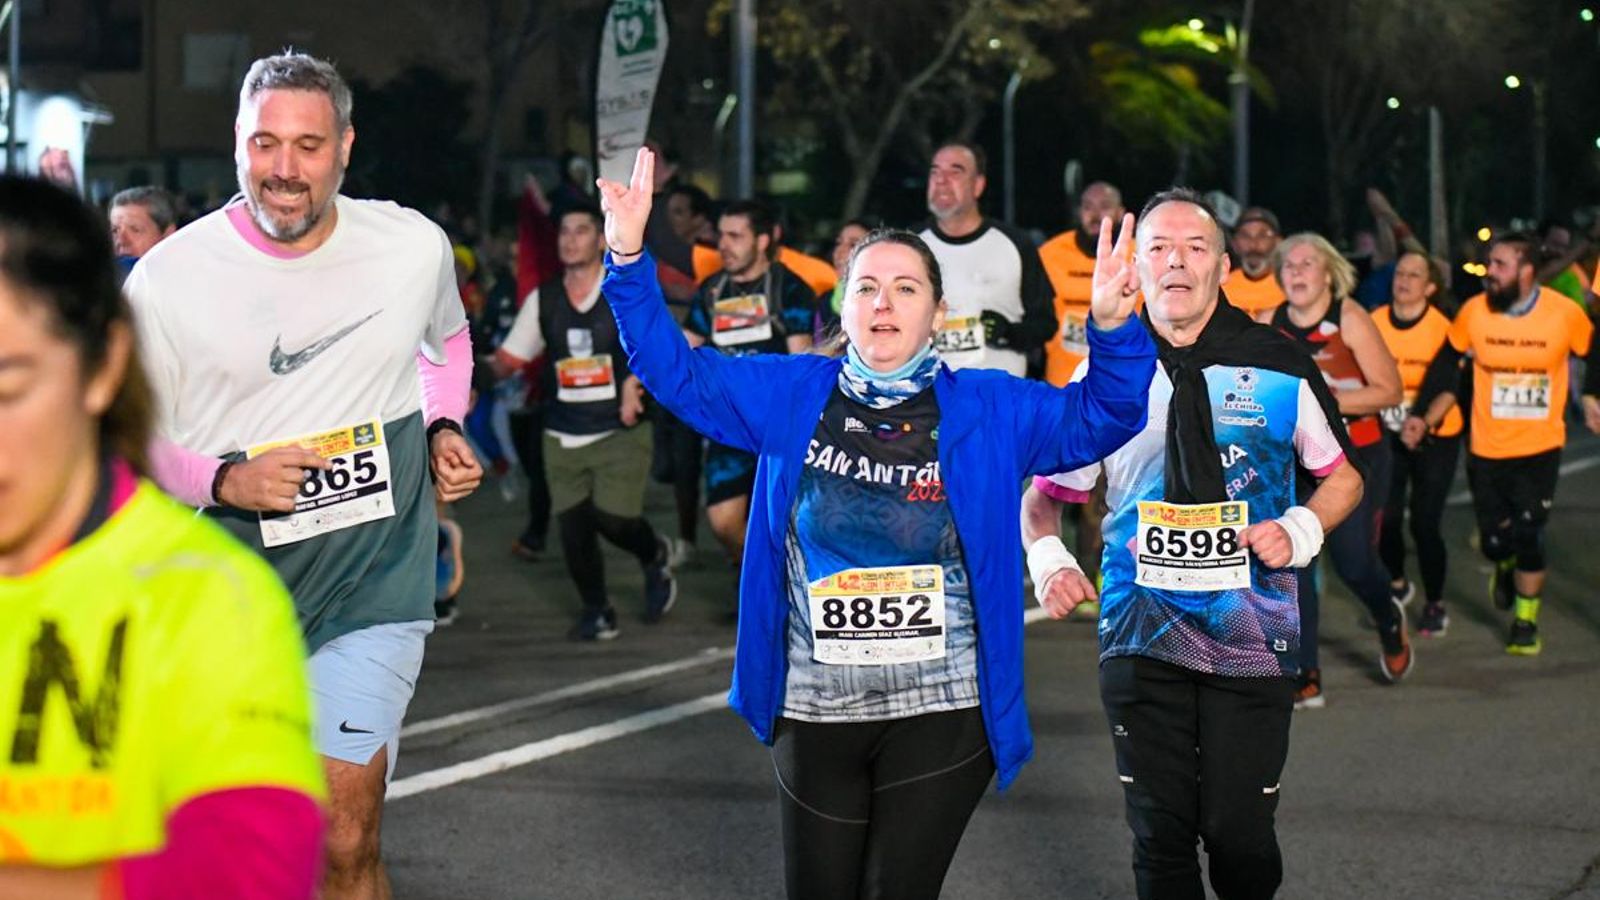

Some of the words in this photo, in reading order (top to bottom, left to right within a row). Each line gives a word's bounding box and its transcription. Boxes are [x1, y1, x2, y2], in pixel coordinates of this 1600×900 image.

[1499, 387, 1547, 406] 7112
[804, 438, 853, 477] SAN
[906, 480, 947, 502] 202
[1146, 526, 1239, 558] 6598
[822, 594, 933, 629] 8852
